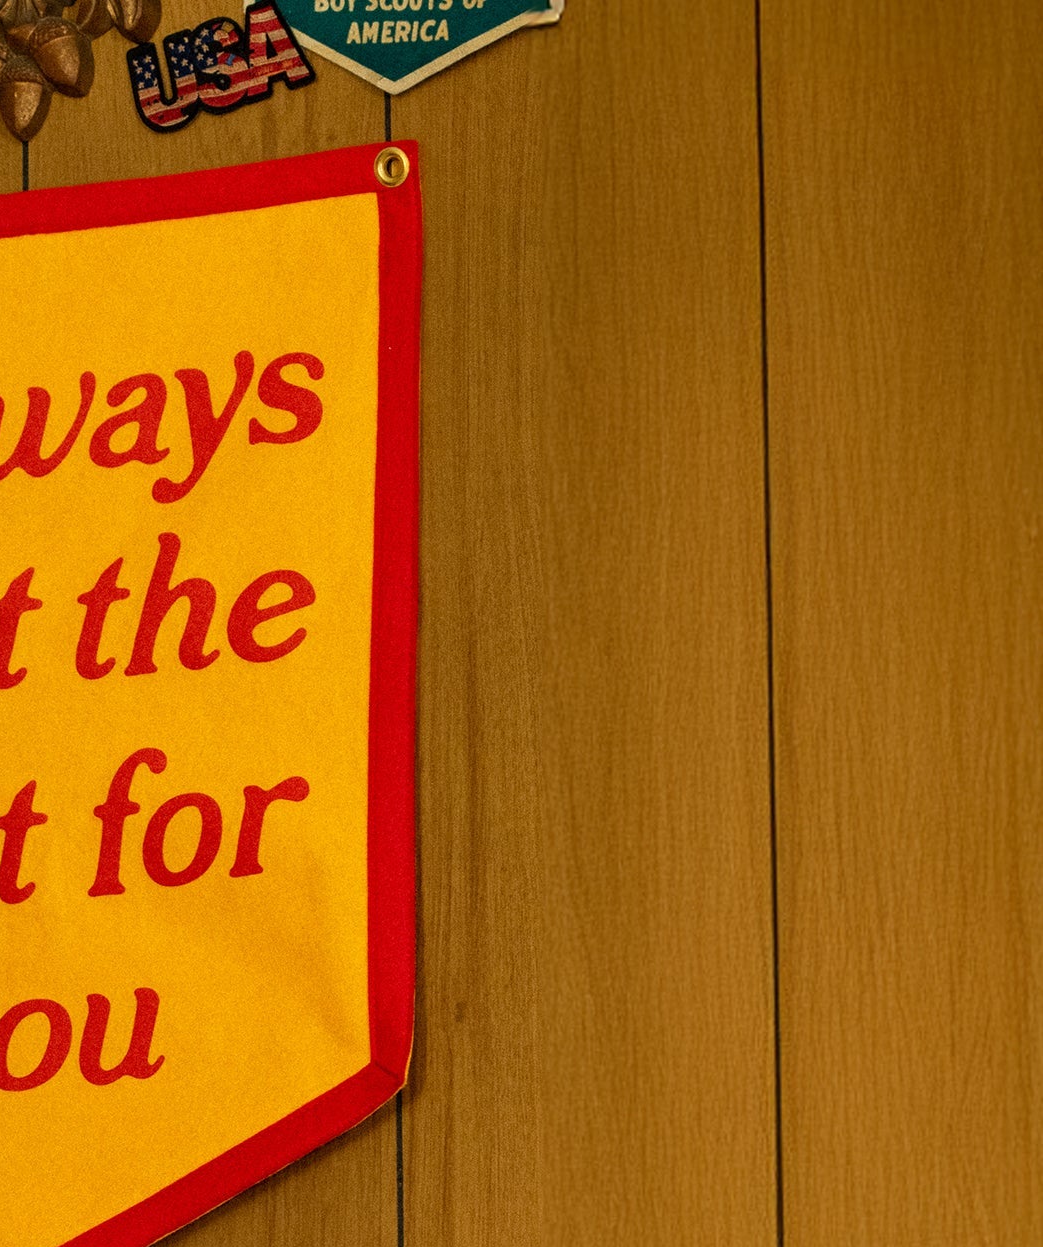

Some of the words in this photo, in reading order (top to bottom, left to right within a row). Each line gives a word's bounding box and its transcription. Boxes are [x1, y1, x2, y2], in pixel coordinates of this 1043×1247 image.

[128, 4, 315, 133] USA
[346, 19, 449, 44] AMERICA
[75, 531, 317, 681] the
[87, 747, 310, 898] for
